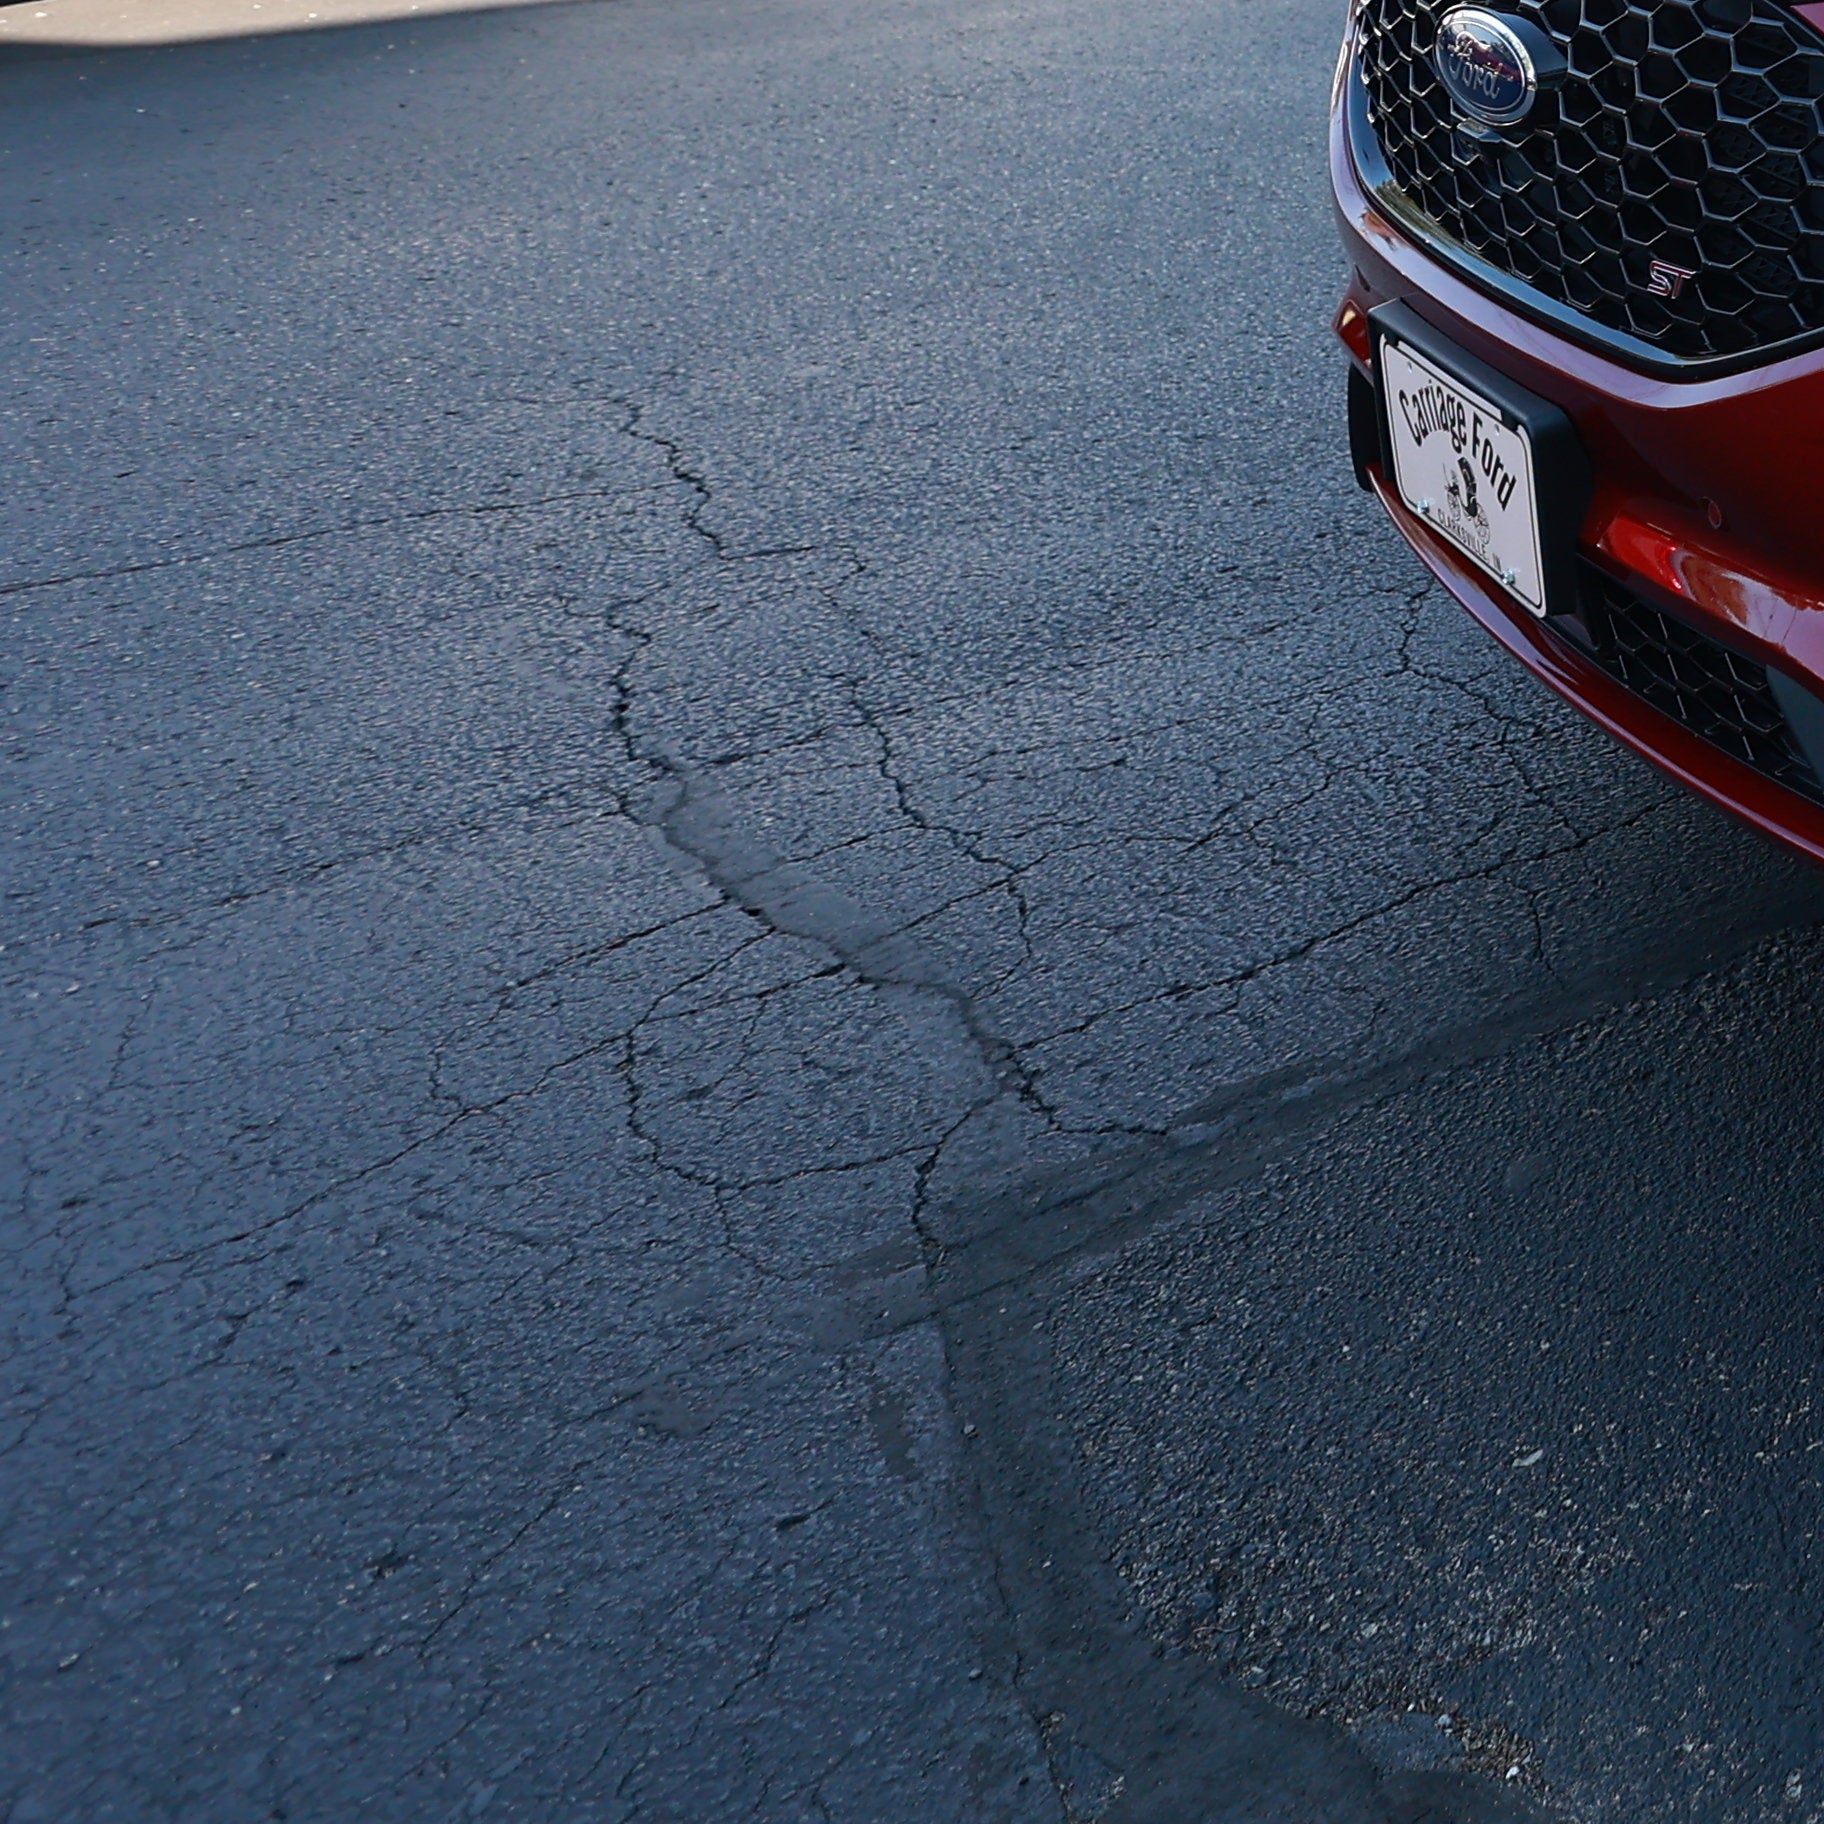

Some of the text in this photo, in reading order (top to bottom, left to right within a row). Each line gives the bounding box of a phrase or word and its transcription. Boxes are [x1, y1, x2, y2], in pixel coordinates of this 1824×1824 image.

[1446, 30, 1515, 100] Ford
[1647, 260, 1697, 299] ST
[1398, 378, 1517, 512] Carriage Ford
